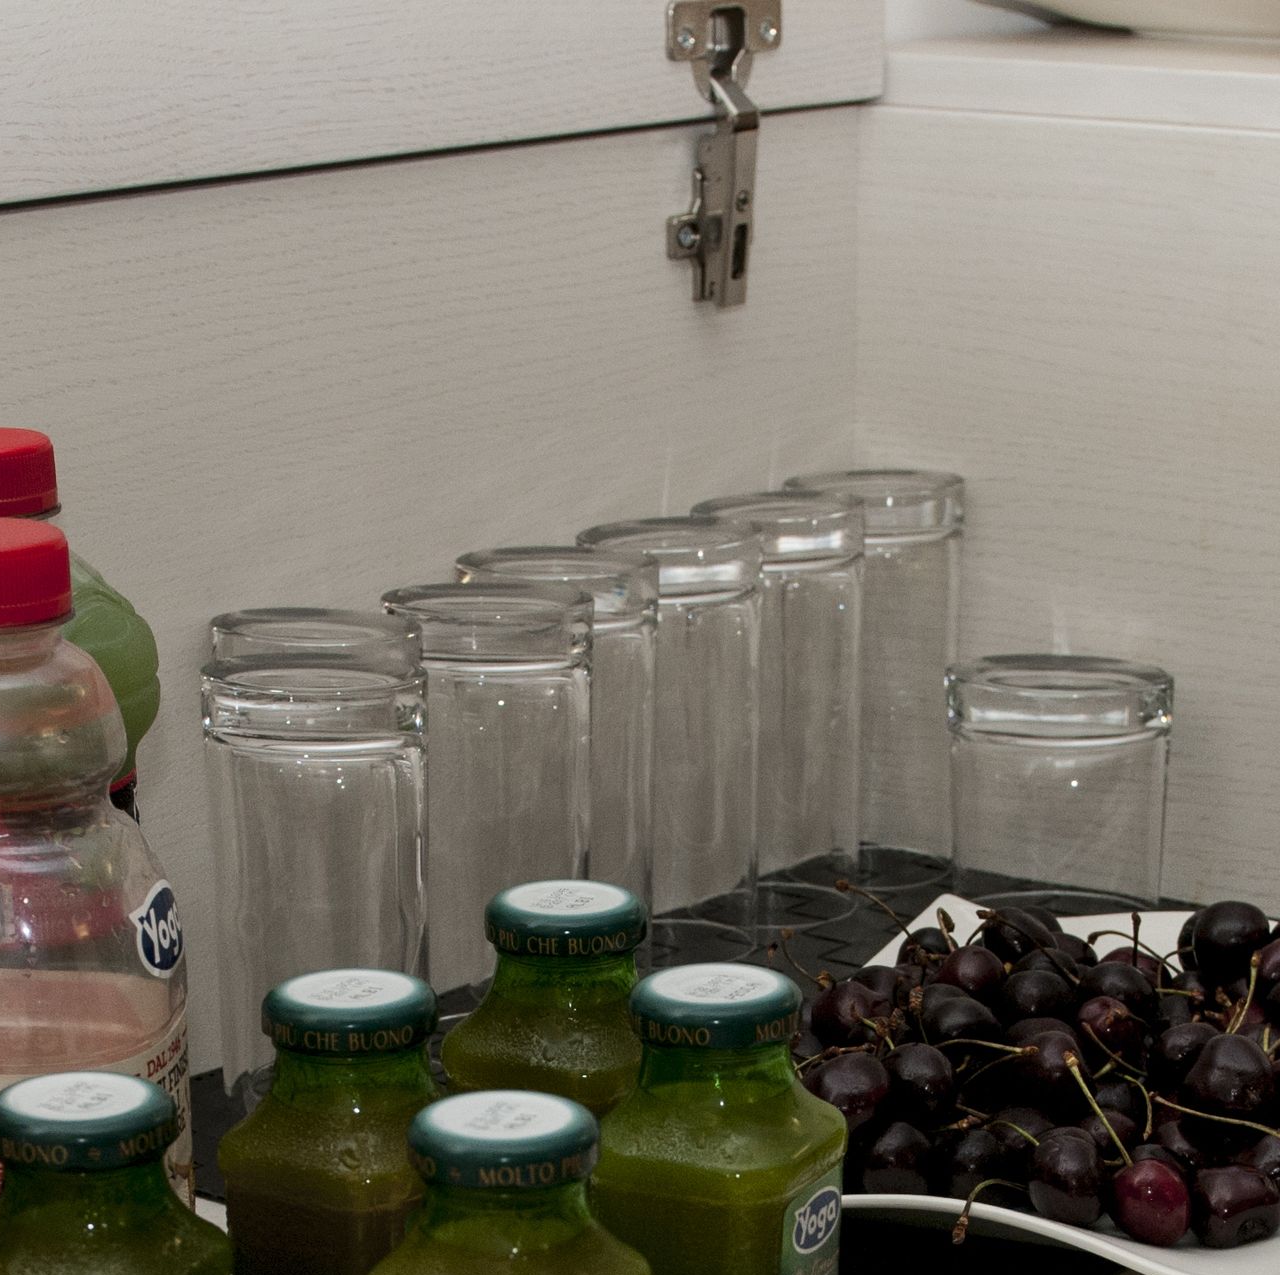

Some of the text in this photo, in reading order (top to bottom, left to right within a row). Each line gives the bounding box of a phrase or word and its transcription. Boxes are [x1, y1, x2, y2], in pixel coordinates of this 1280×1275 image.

[527, 935, 560, 956] CHE
[568, 930, 626, 955] BUONO
[303, 1030, 341, 1052] CHE
[348, 1024, 414, 1052] BUONO
[648, 1019, 711, 1046] BUONO
[798, 1198, 839, 1246] Yoga
